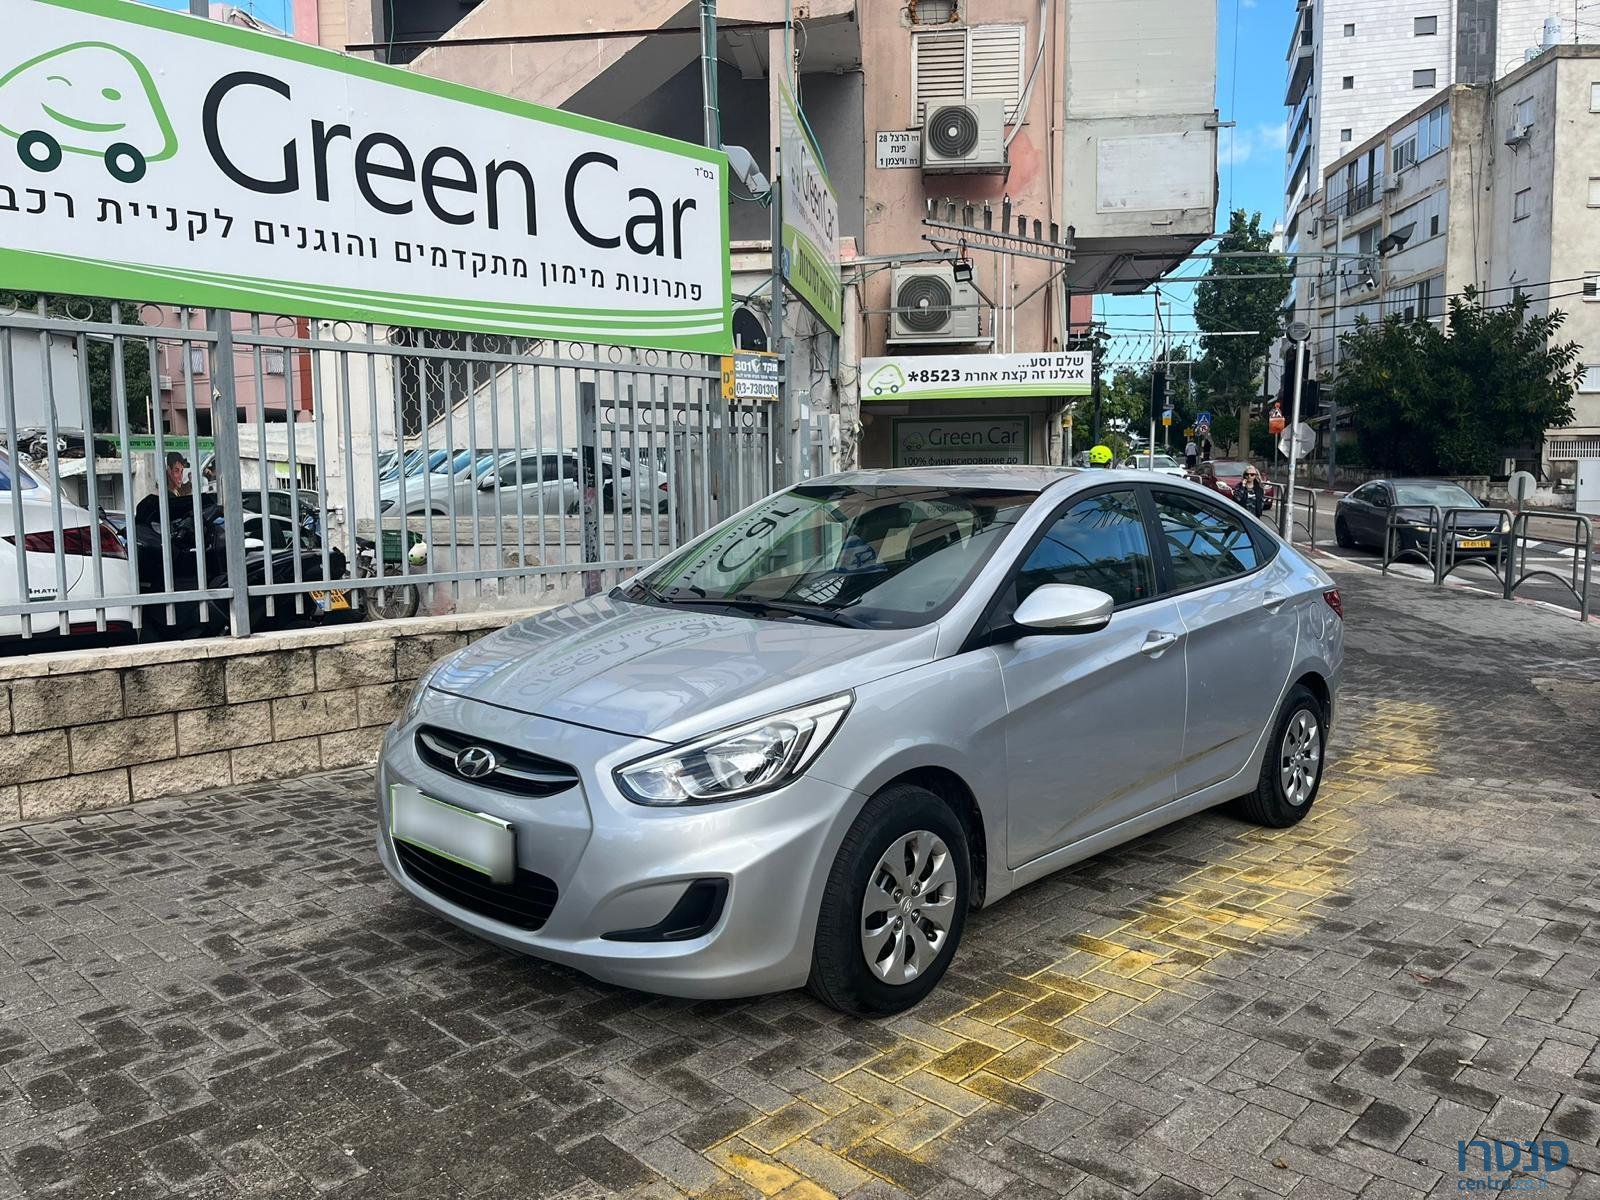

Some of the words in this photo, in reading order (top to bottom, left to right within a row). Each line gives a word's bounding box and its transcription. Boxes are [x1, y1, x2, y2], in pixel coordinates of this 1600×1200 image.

[879, 134, 888, 142] 28
[890, 133, 910, 142] הרצל
[890, 145, 907, 153] פינת
[203, 72, 537, 236] Green
[565, 152, 697, 260] Car
[801, 146, 823, 228] Green
[0, 185, 75, 219] רכב
[97, 198, 234, 242] לקניית
[255, 220, 377, 260] והוגנים
[395, 241, 528, 279] מתקדמים
[541, 262, 605, 289] מימון
[616, 272, 702, 301] פתרונות
[735, 360, 752, 372] 301
[1018, 358, 1053, 368] וסע...
[1057, 355, 1084, 367] שלם
[964, 371, 998, 382] אחרת
[1002, 371, 1028, 383] קצת
[1032, 370, 1046, 380] זה
[1049, 367, 1084, 379] אצלנו
[737, 382, 778, 396] 03-7301301
[928, 428, 983, 446] Green
[987, 426, 1019, 445] Car
[903, 457, 926, 467] 100%
[928, 456, 1005, 466] финансирование
